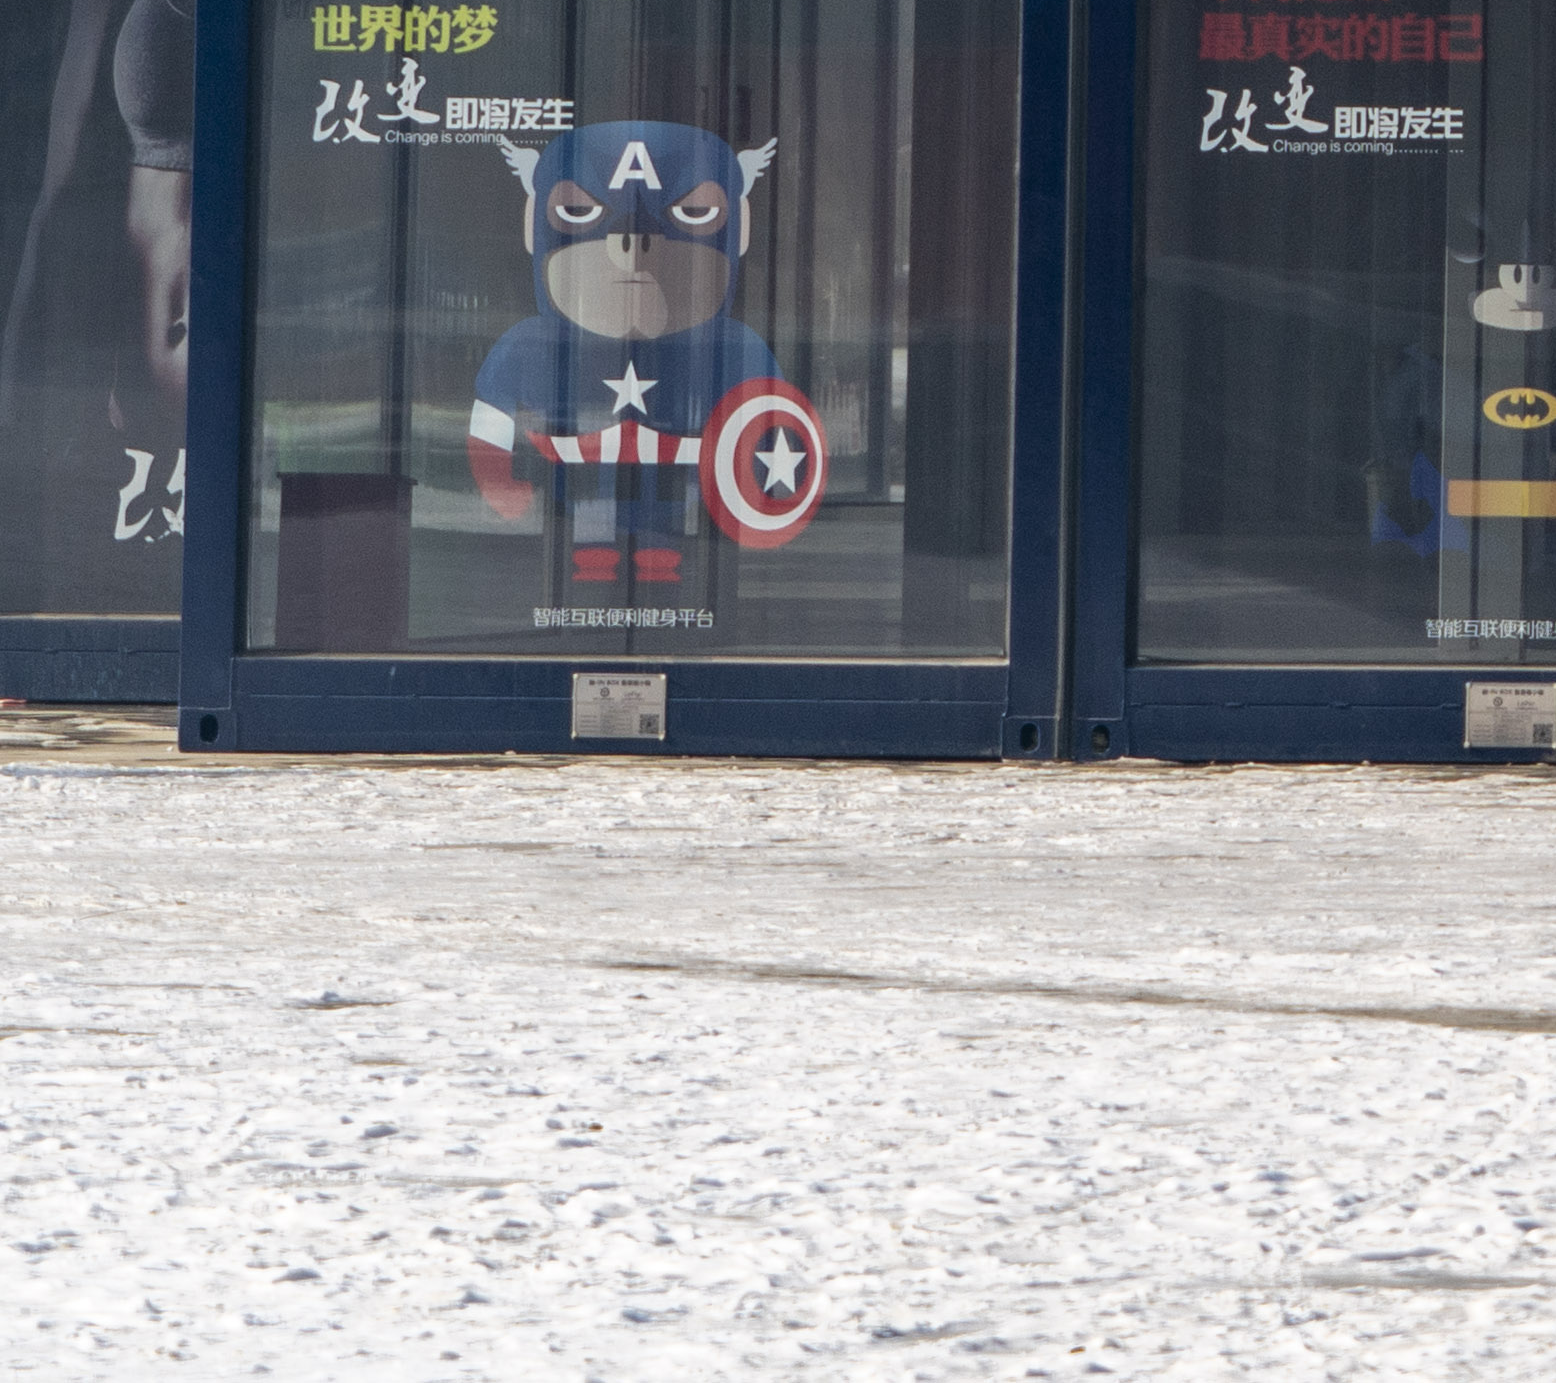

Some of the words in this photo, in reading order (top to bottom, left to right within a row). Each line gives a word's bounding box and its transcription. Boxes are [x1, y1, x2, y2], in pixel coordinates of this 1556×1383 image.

[311, 5, 499, 53] 世界的梦
[1199, 12, 1483, 62] 最真实的自己
[385, 129, 439, 146] Change
[441, 129, 453, 143] is
[1273, 139, 1326, 155] Change
[1330, 139, 1341, 152] is
[609, 141, 662, 190] A
[533, 607, 714, 629] 智能互联便利健身平台
